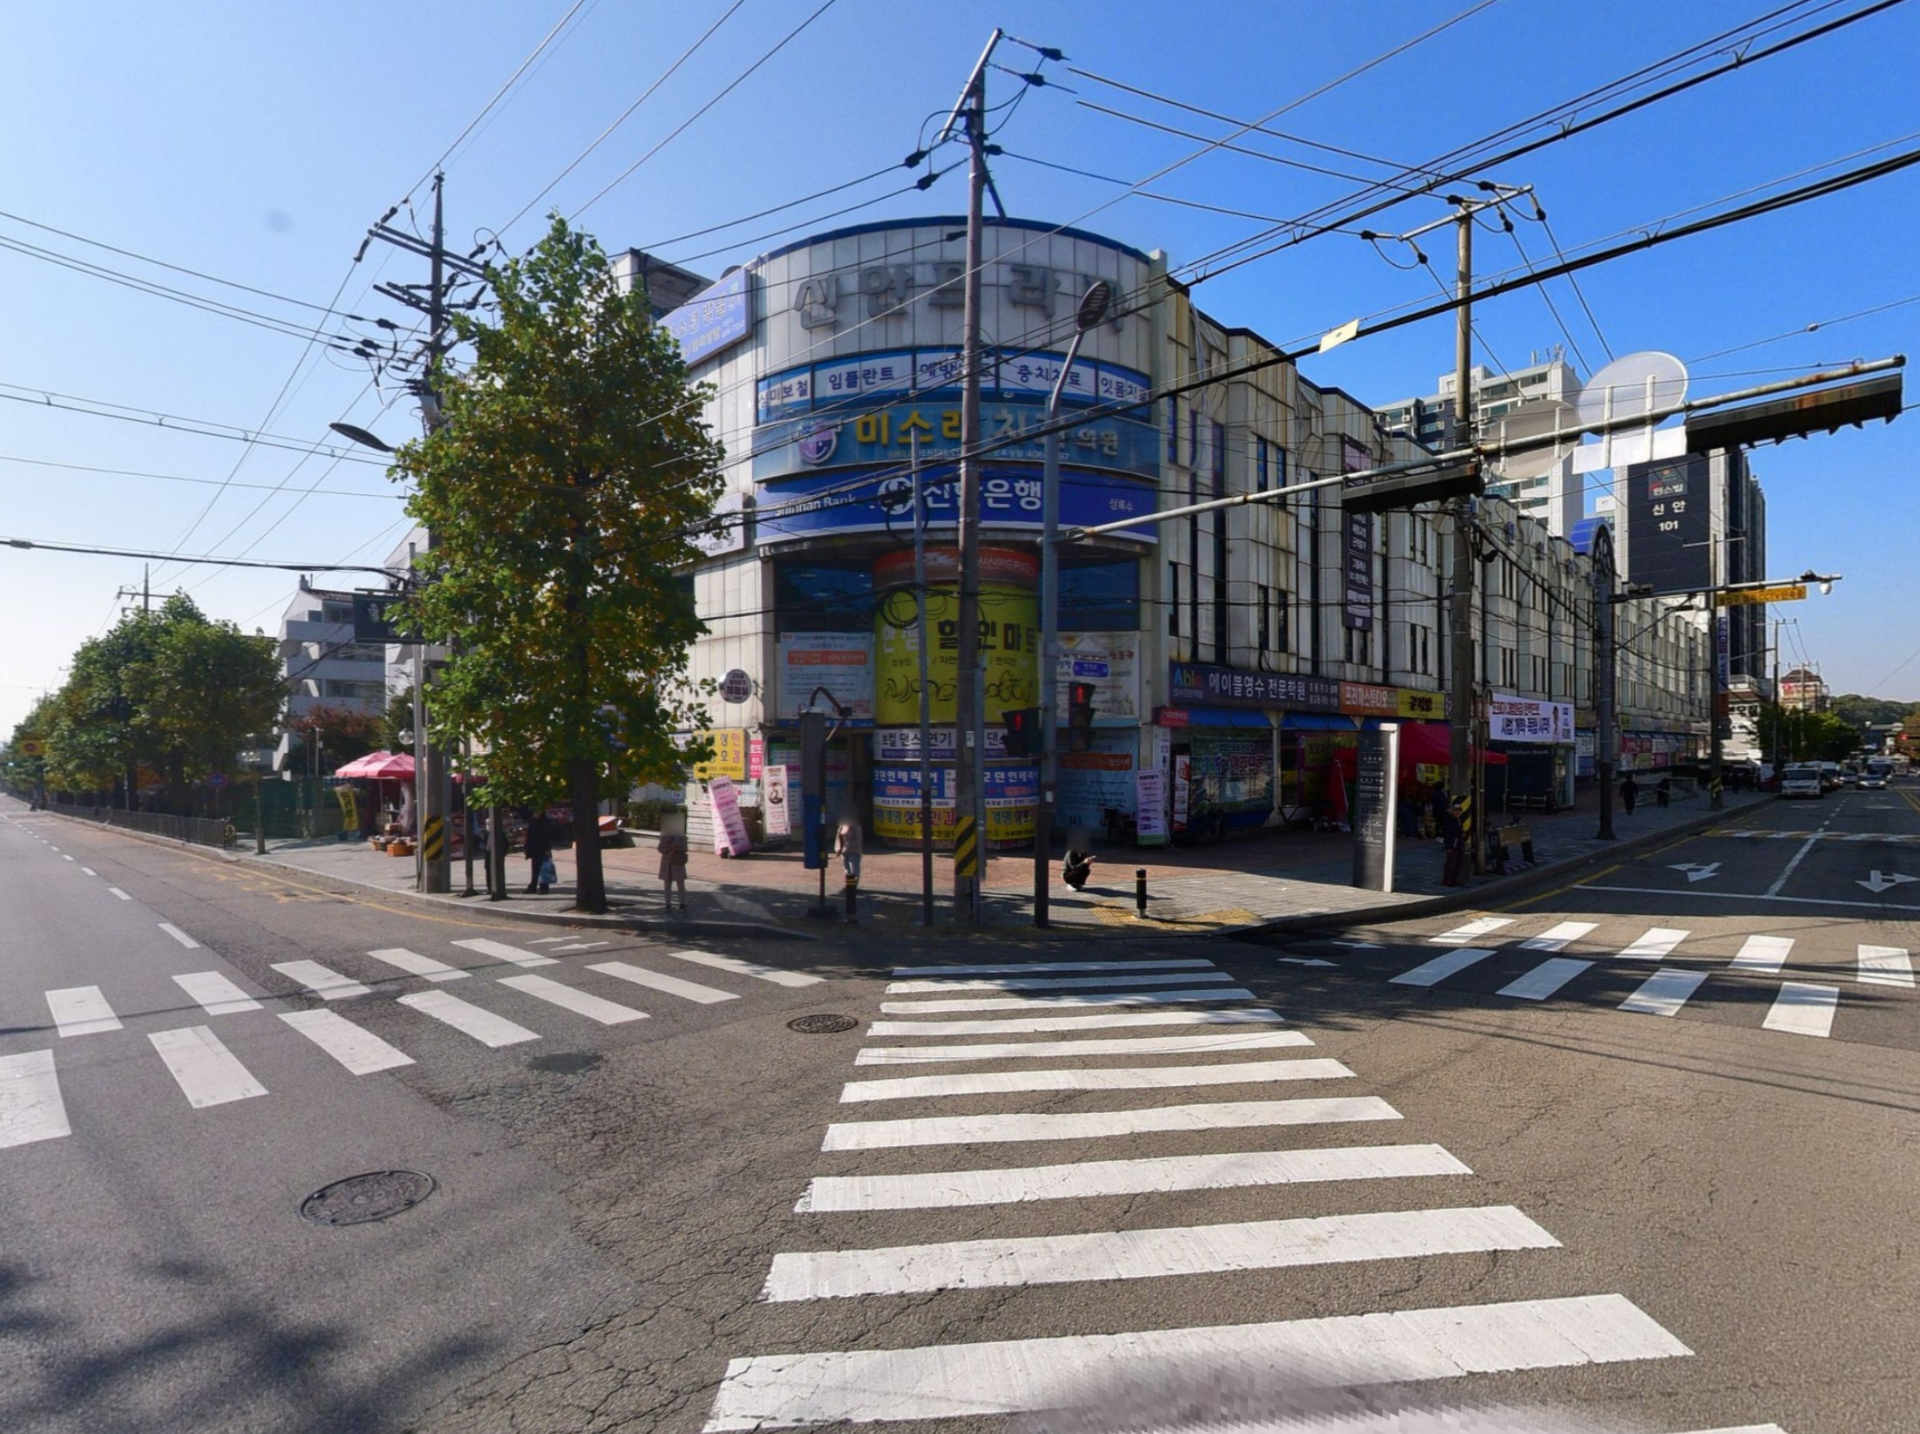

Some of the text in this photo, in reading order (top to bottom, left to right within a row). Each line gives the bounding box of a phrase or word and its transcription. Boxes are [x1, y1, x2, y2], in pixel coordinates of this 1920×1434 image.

[828, 366, 895, 390] 임플란트
[1659, 520, 1679, 532] 101
[1208, 672, 1306, 700] 에이블영수 전문학원
[882, 732, 896, 747] 보컬
[900, 732, 921, 747] 댄스
[987, 731, 1006, 746] 댄
